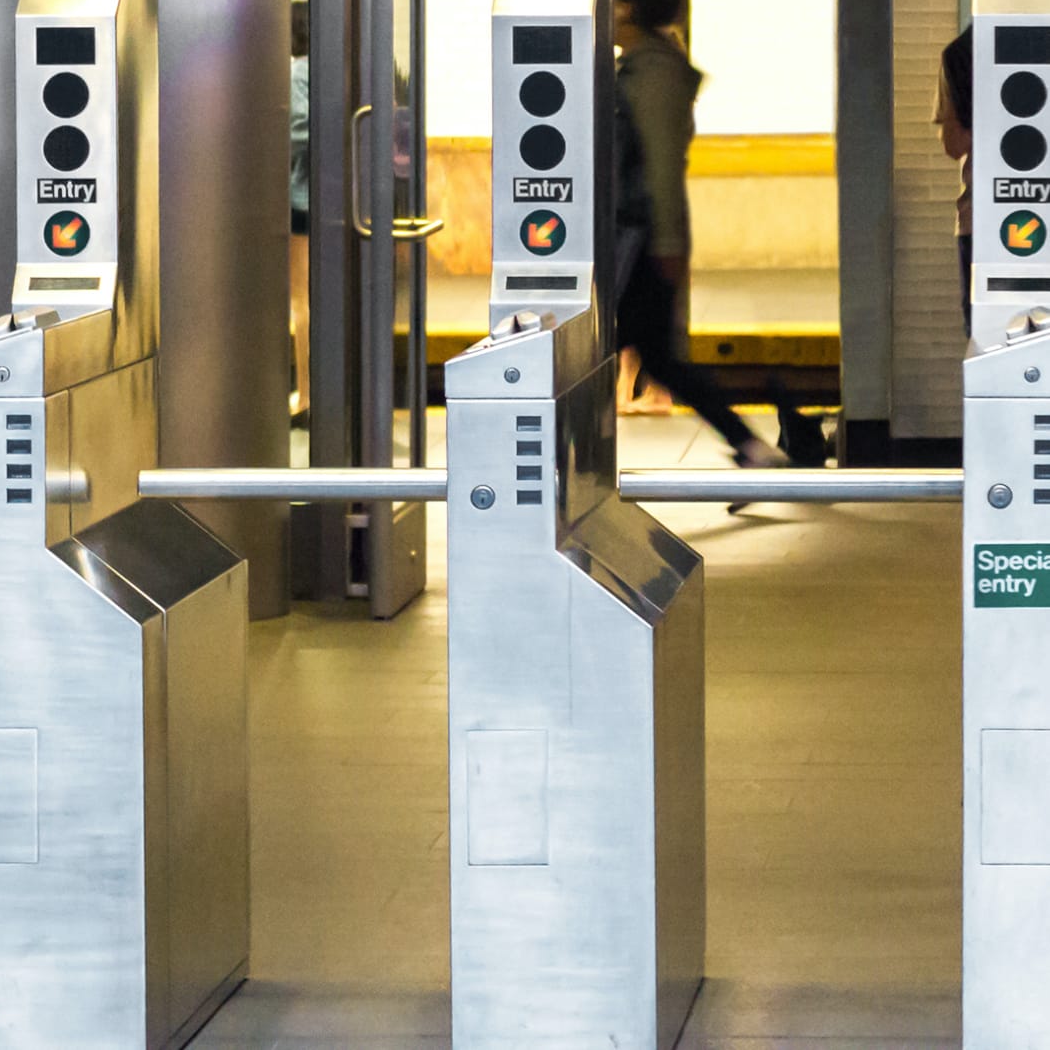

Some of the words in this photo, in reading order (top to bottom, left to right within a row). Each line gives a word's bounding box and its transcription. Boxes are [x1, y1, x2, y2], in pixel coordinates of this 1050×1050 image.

[39, 180, 95, 203] Entry
[515, 179, 570, 202] Entry
[995, 179, 1050, 202] Entry
[978, 574, 1037, 597] entry
